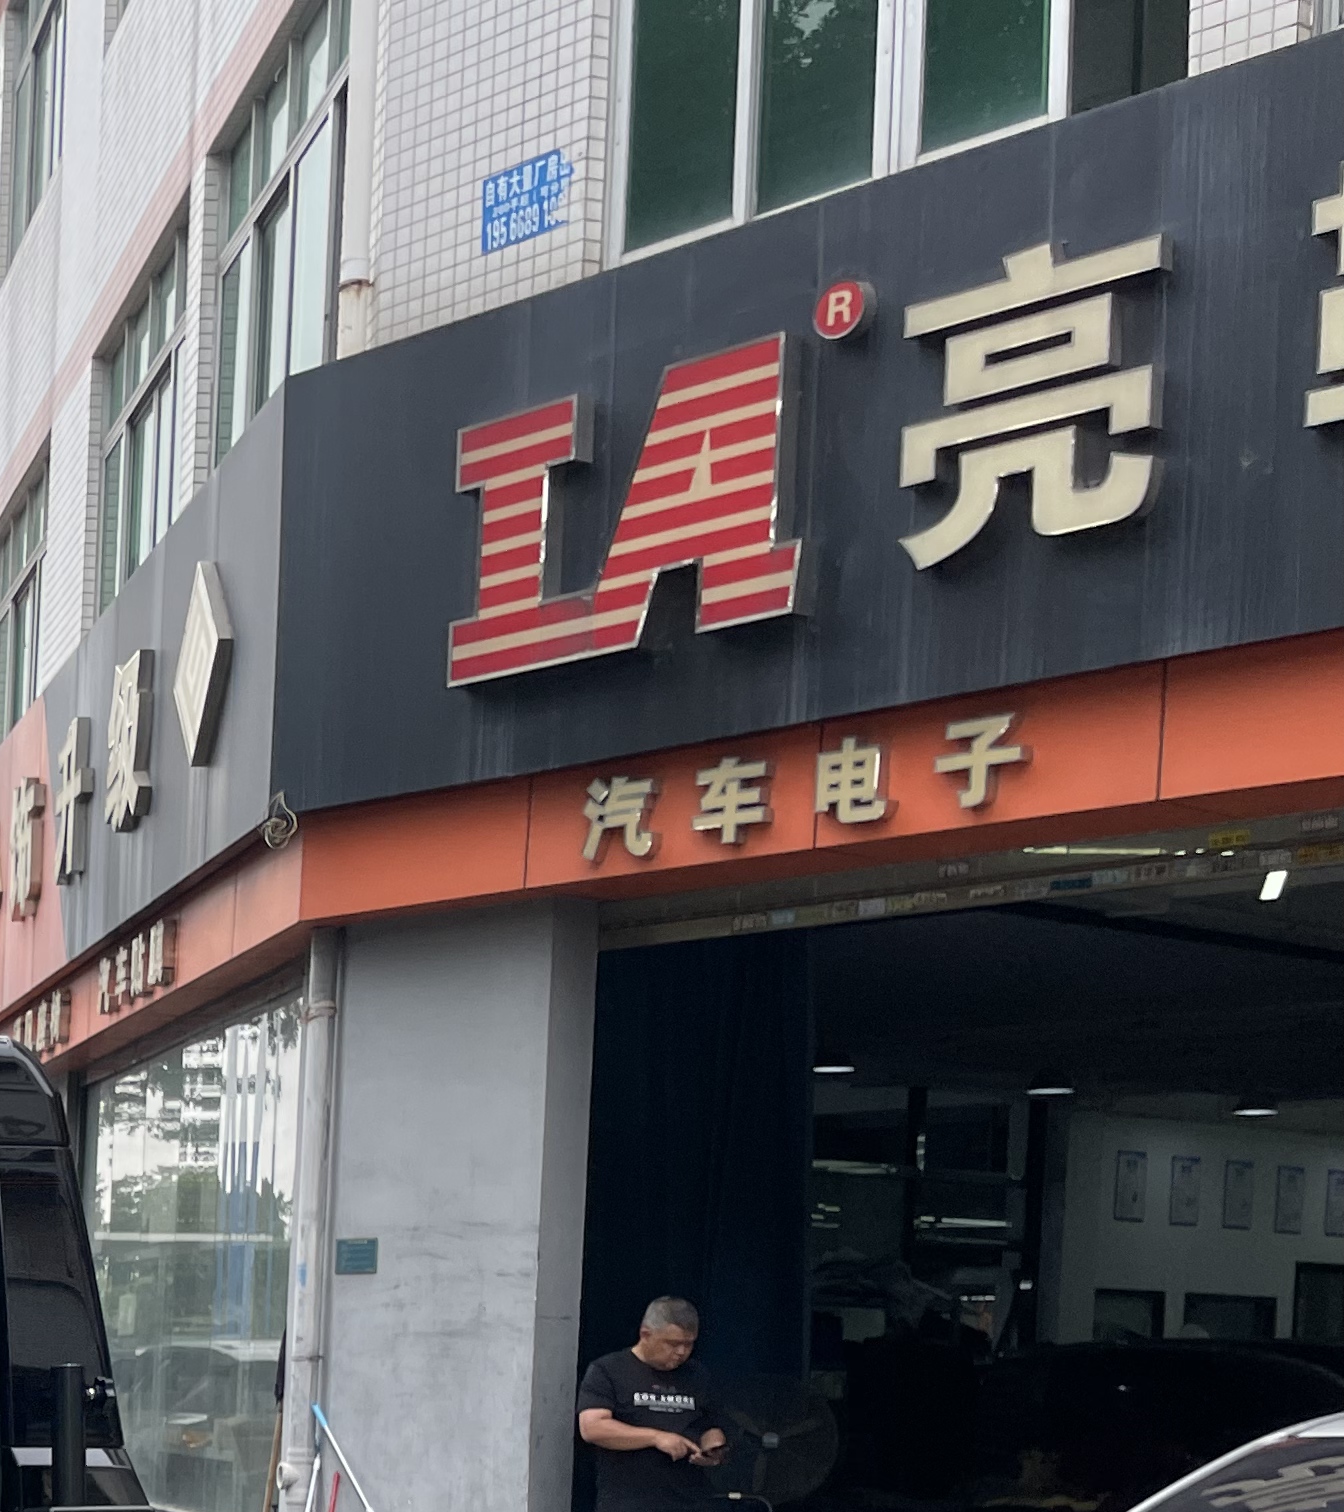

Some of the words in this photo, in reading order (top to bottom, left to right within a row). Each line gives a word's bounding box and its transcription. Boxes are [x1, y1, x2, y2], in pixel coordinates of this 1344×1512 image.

[486, 216, 508, 250] 195
[582, 712, 1032, 863] 汽车电子
